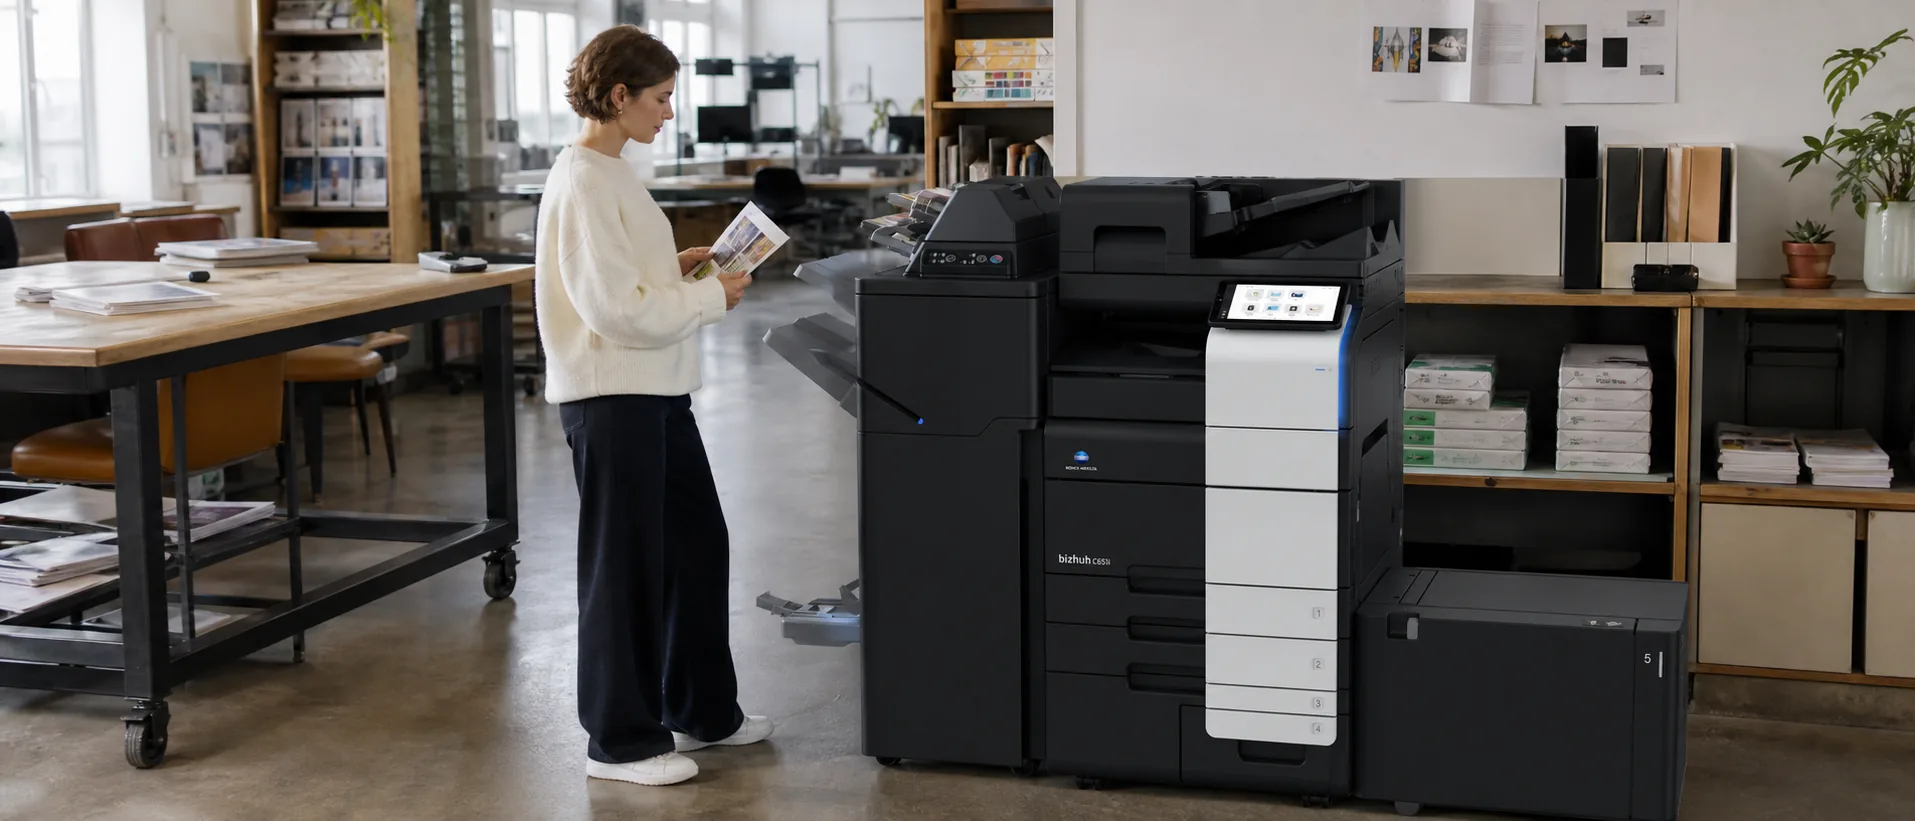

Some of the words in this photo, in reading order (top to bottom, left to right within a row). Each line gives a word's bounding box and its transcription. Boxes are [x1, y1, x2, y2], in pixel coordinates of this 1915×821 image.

[1644, 653, 1652, 664] 5
[1315, 660, 1321, 669] 2
[1315, 699, 1321, 708] 3
[1315, 725, 1321, 733] 4
